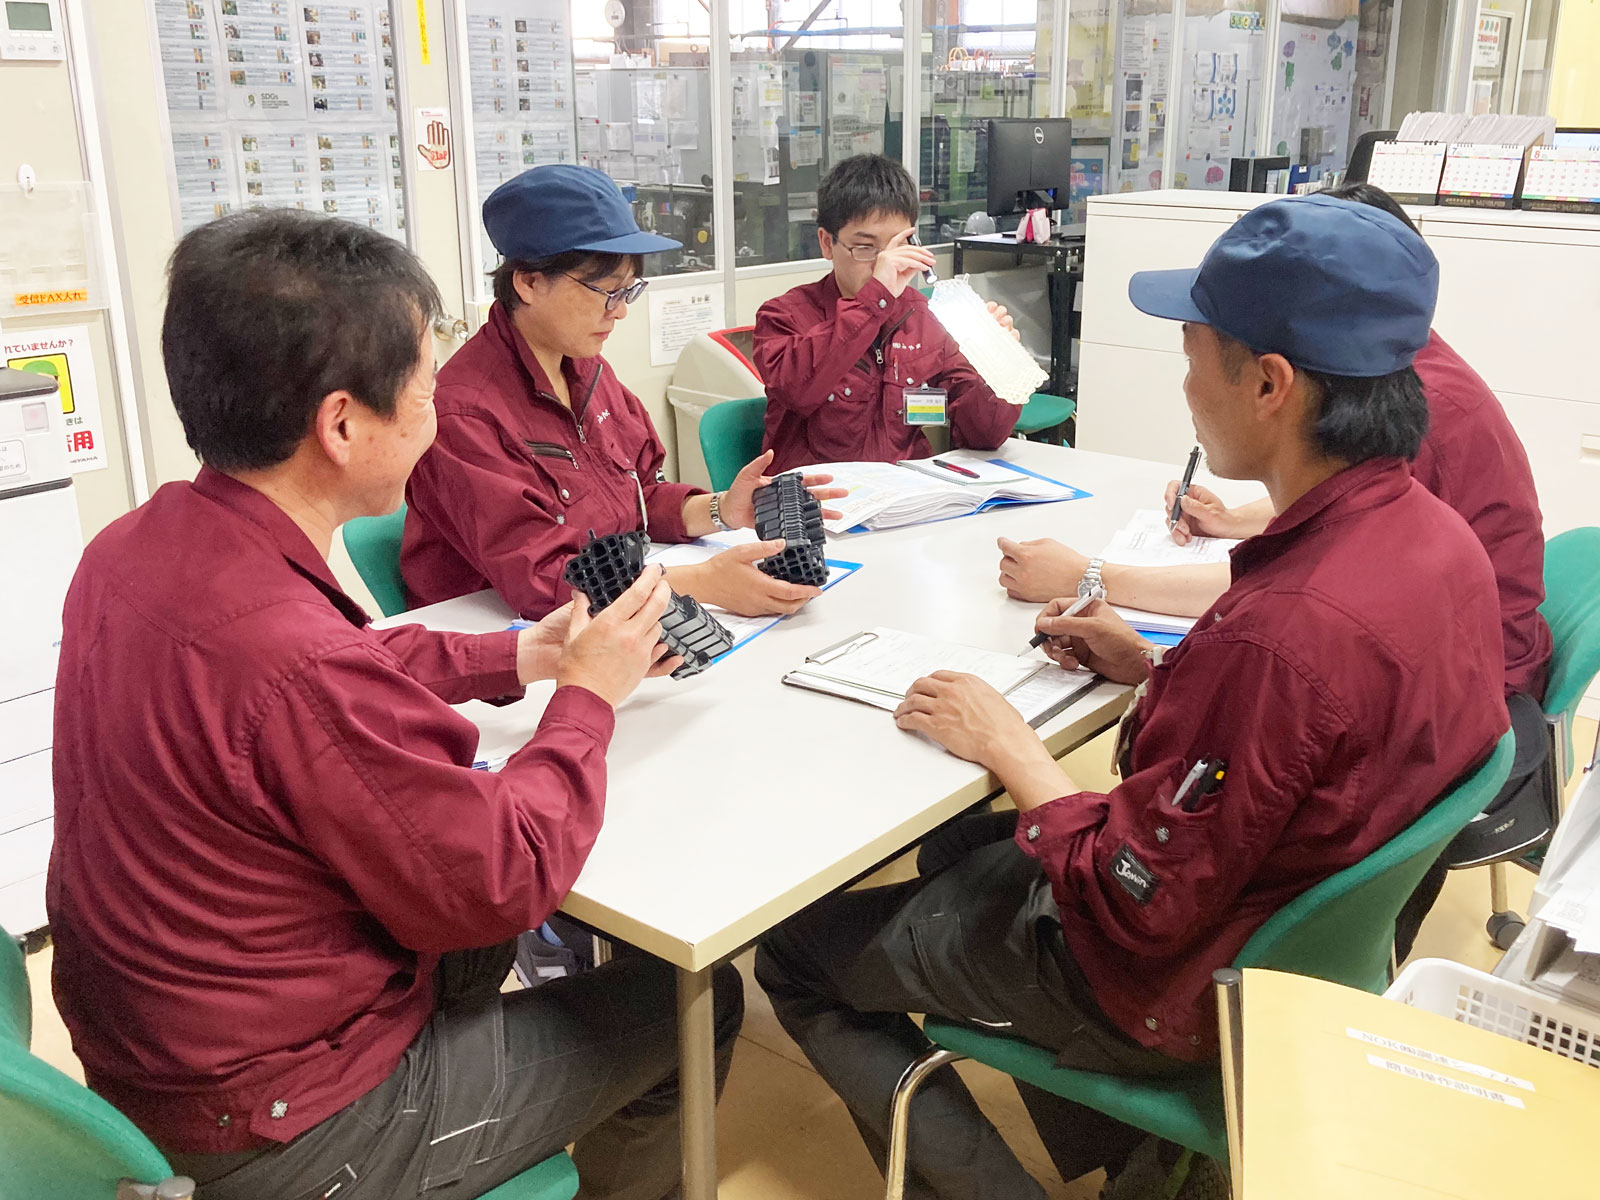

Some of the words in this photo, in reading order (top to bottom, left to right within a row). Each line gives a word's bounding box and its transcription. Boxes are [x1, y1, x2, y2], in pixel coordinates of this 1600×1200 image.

[1452, 147, 1457, 155] 7
[1534, 150, 1540, 159] 8
[19, 292, 82, 305] 受信FAX入れ
[66, 430, 94, 453] 用
[1116, 859, 1147, 888] Jawin
